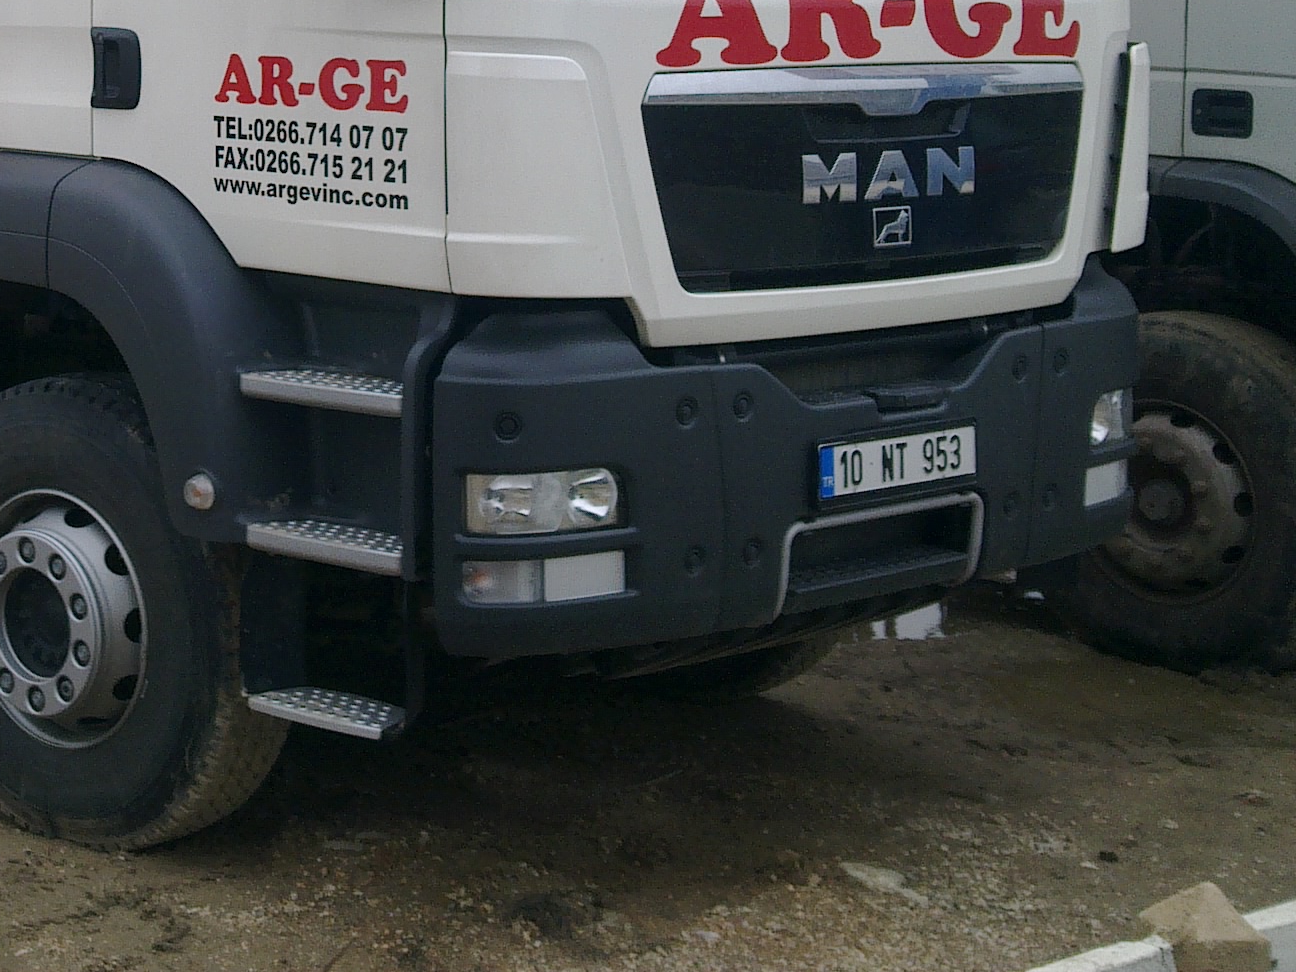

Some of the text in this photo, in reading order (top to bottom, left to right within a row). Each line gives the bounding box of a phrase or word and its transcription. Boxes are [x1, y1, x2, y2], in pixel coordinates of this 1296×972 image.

[214, 53, 409, 113] AR-GE
[213, 115, 408, 151] TEL:0266.714 07 07
[215, 145, 407, 183] FAX:0266.715 21 21
[802, 146, 975, 204] MAN
[214, 177, 409, 210] www.argevinc.com
[840, 435, 961, 488] 10 NT 953
